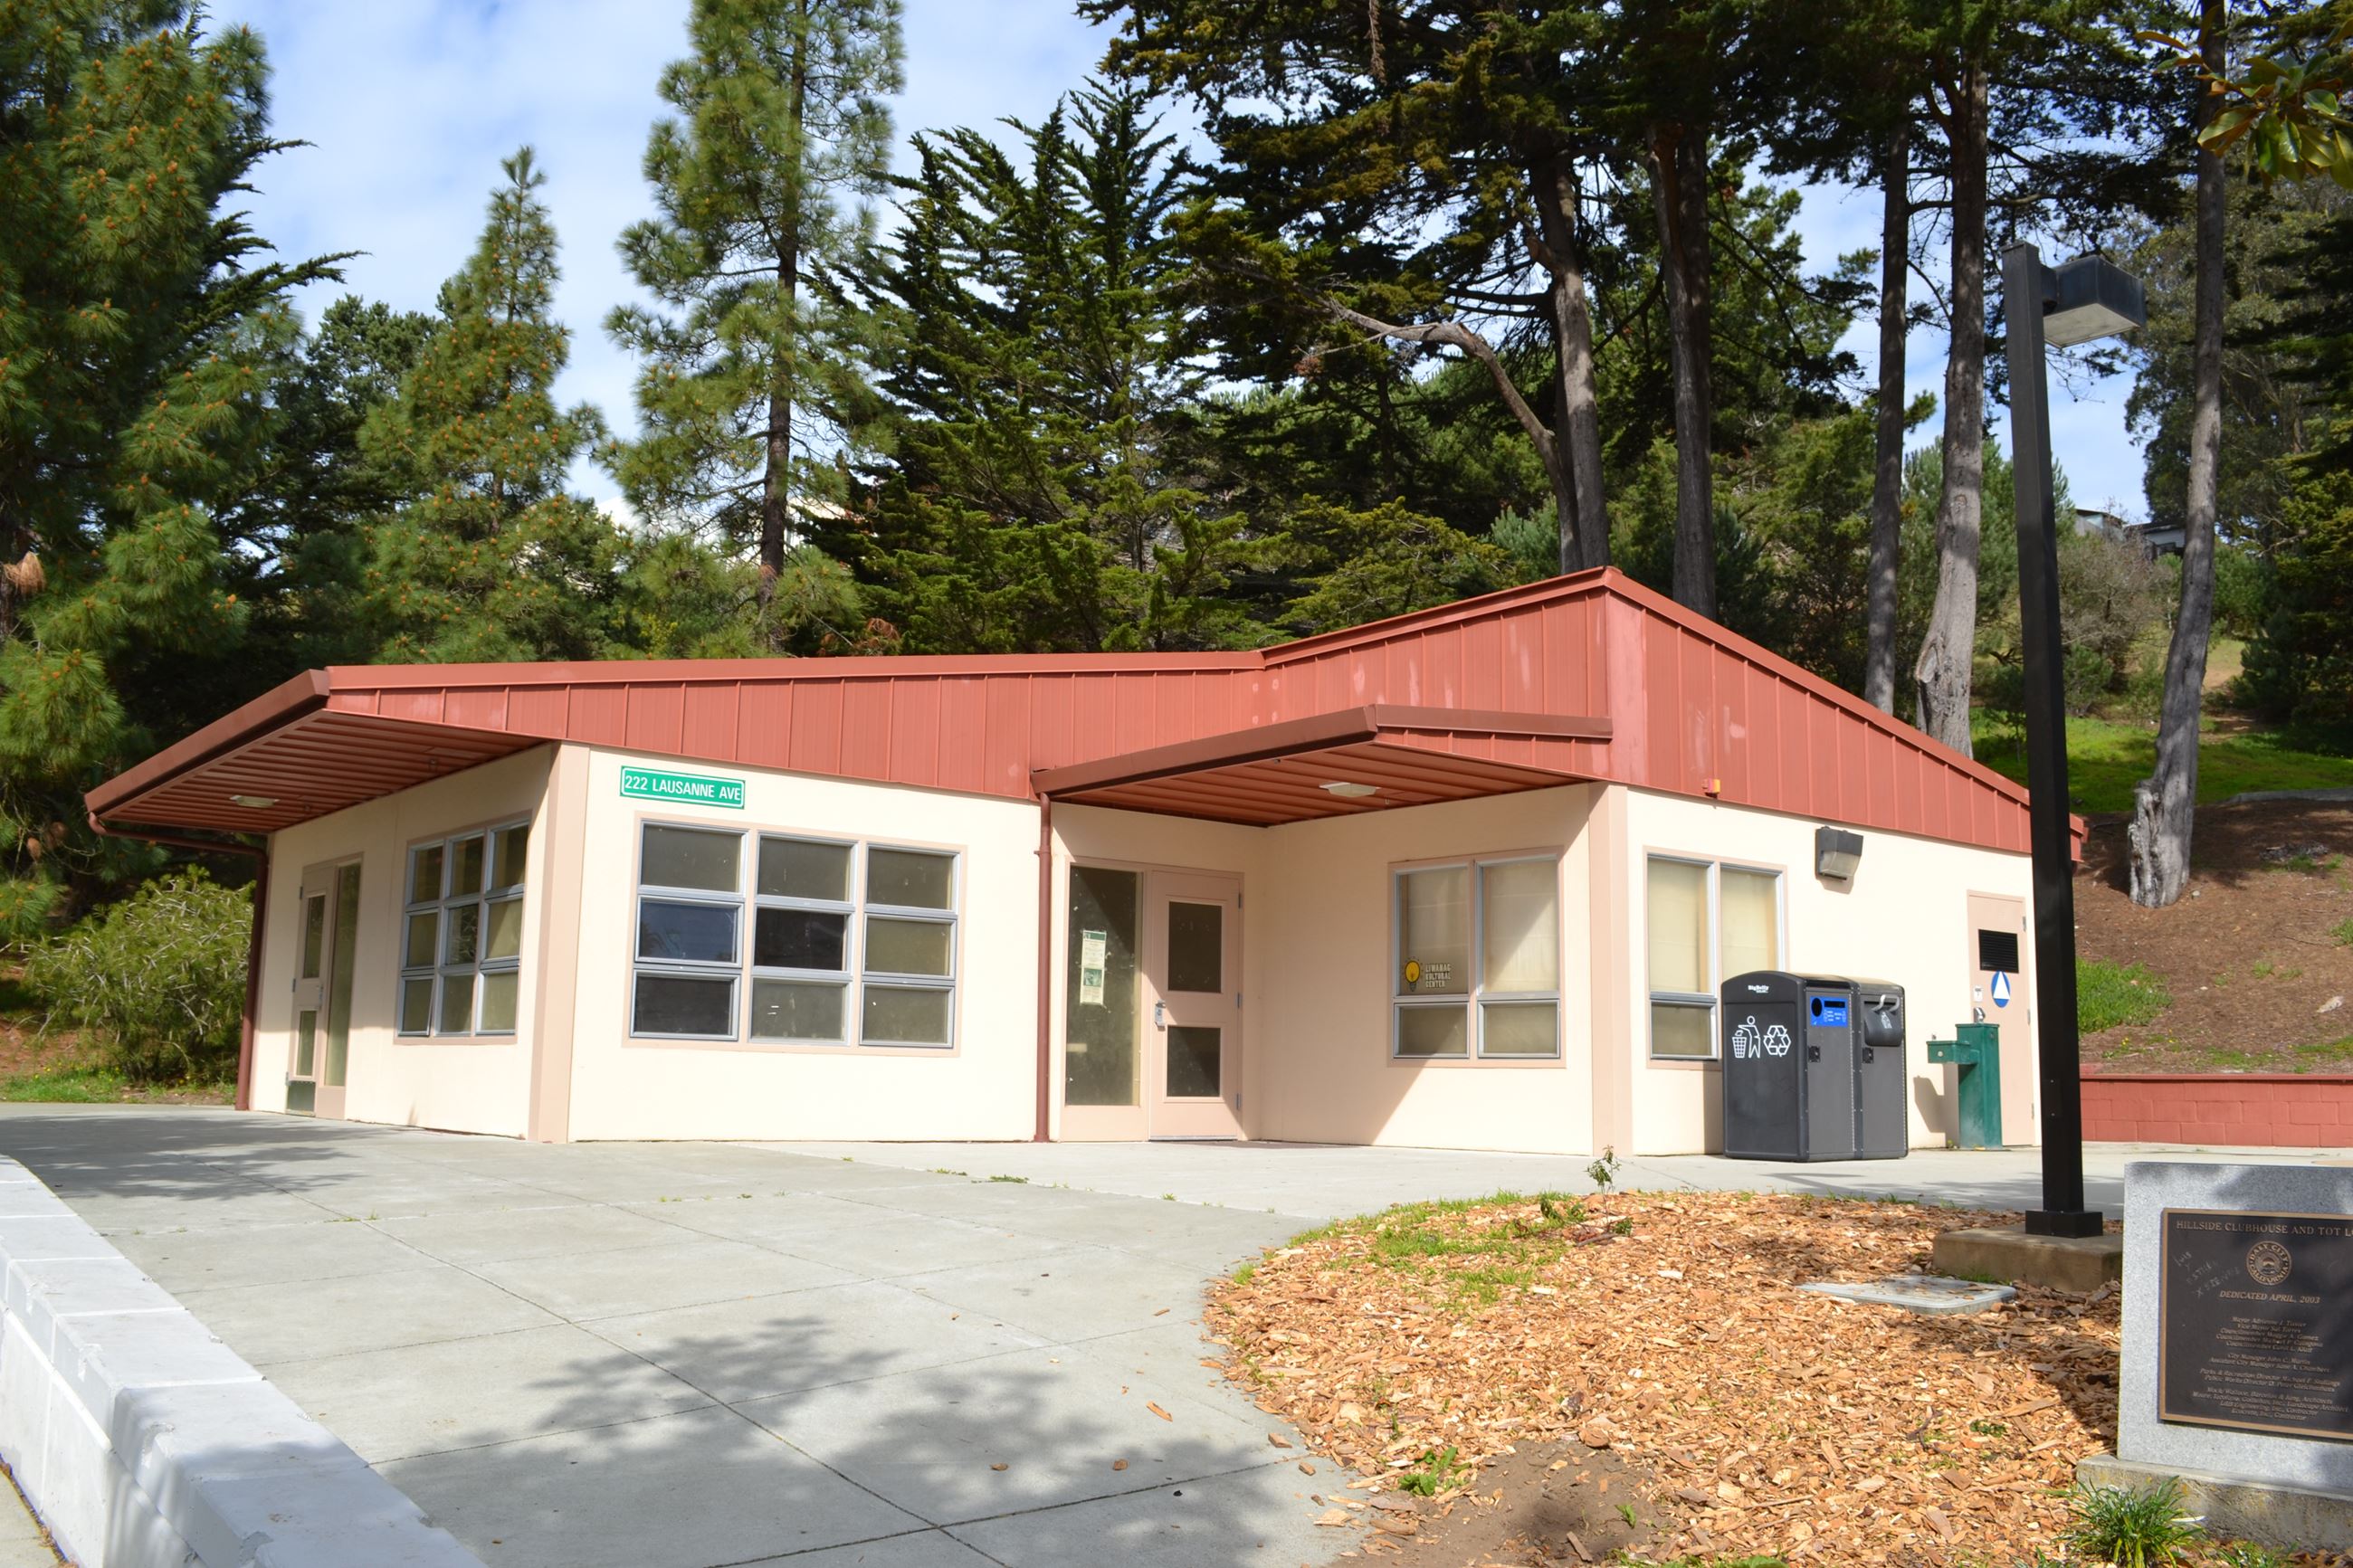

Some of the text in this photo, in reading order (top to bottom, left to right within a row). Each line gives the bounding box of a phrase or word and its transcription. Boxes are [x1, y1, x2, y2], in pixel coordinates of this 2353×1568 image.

[624, 775, 741, 801] 222 LAUSANNE AVE
[1425, 980, 1445, 988] CENTER
[2177, 1221, 2222, 1231] HILLSIDE
[2224, 1222, 2289, 1234] CLUBHOUSE
[2291, 1225, 2314, 1235] AND
[2319, 1227, 2342, 1237] TOT
[2250, 1244, 2288, 1261] DALY CITY
[2250, 1264, 2288, 1283] CALIFORNIA
[2219, 1290, 2267, 1301] DEDICATED
[2299, 1295, 2321, 1305] 2003
